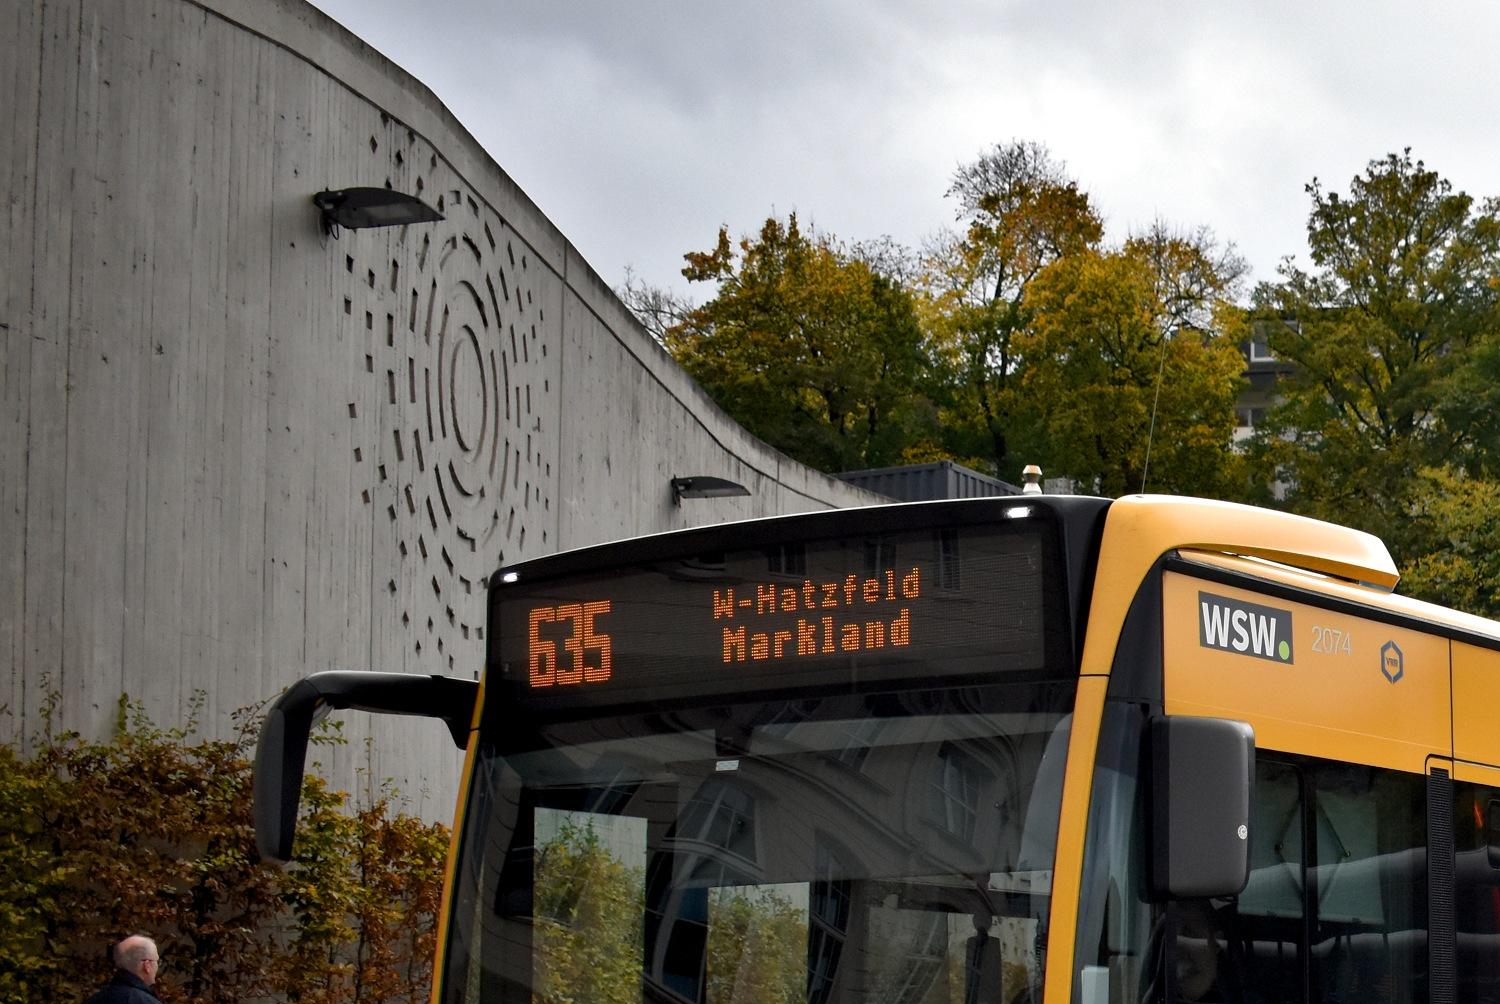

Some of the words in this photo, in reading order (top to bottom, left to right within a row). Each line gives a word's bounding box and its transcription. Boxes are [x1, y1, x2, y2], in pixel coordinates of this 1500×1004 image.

[713, 567, 919, 620] W-Hatzfeld
[529, 600, 611, 687] 635
[723, 608, 909, 663] Markland
[1311, 625, 1352, 656] 2074
